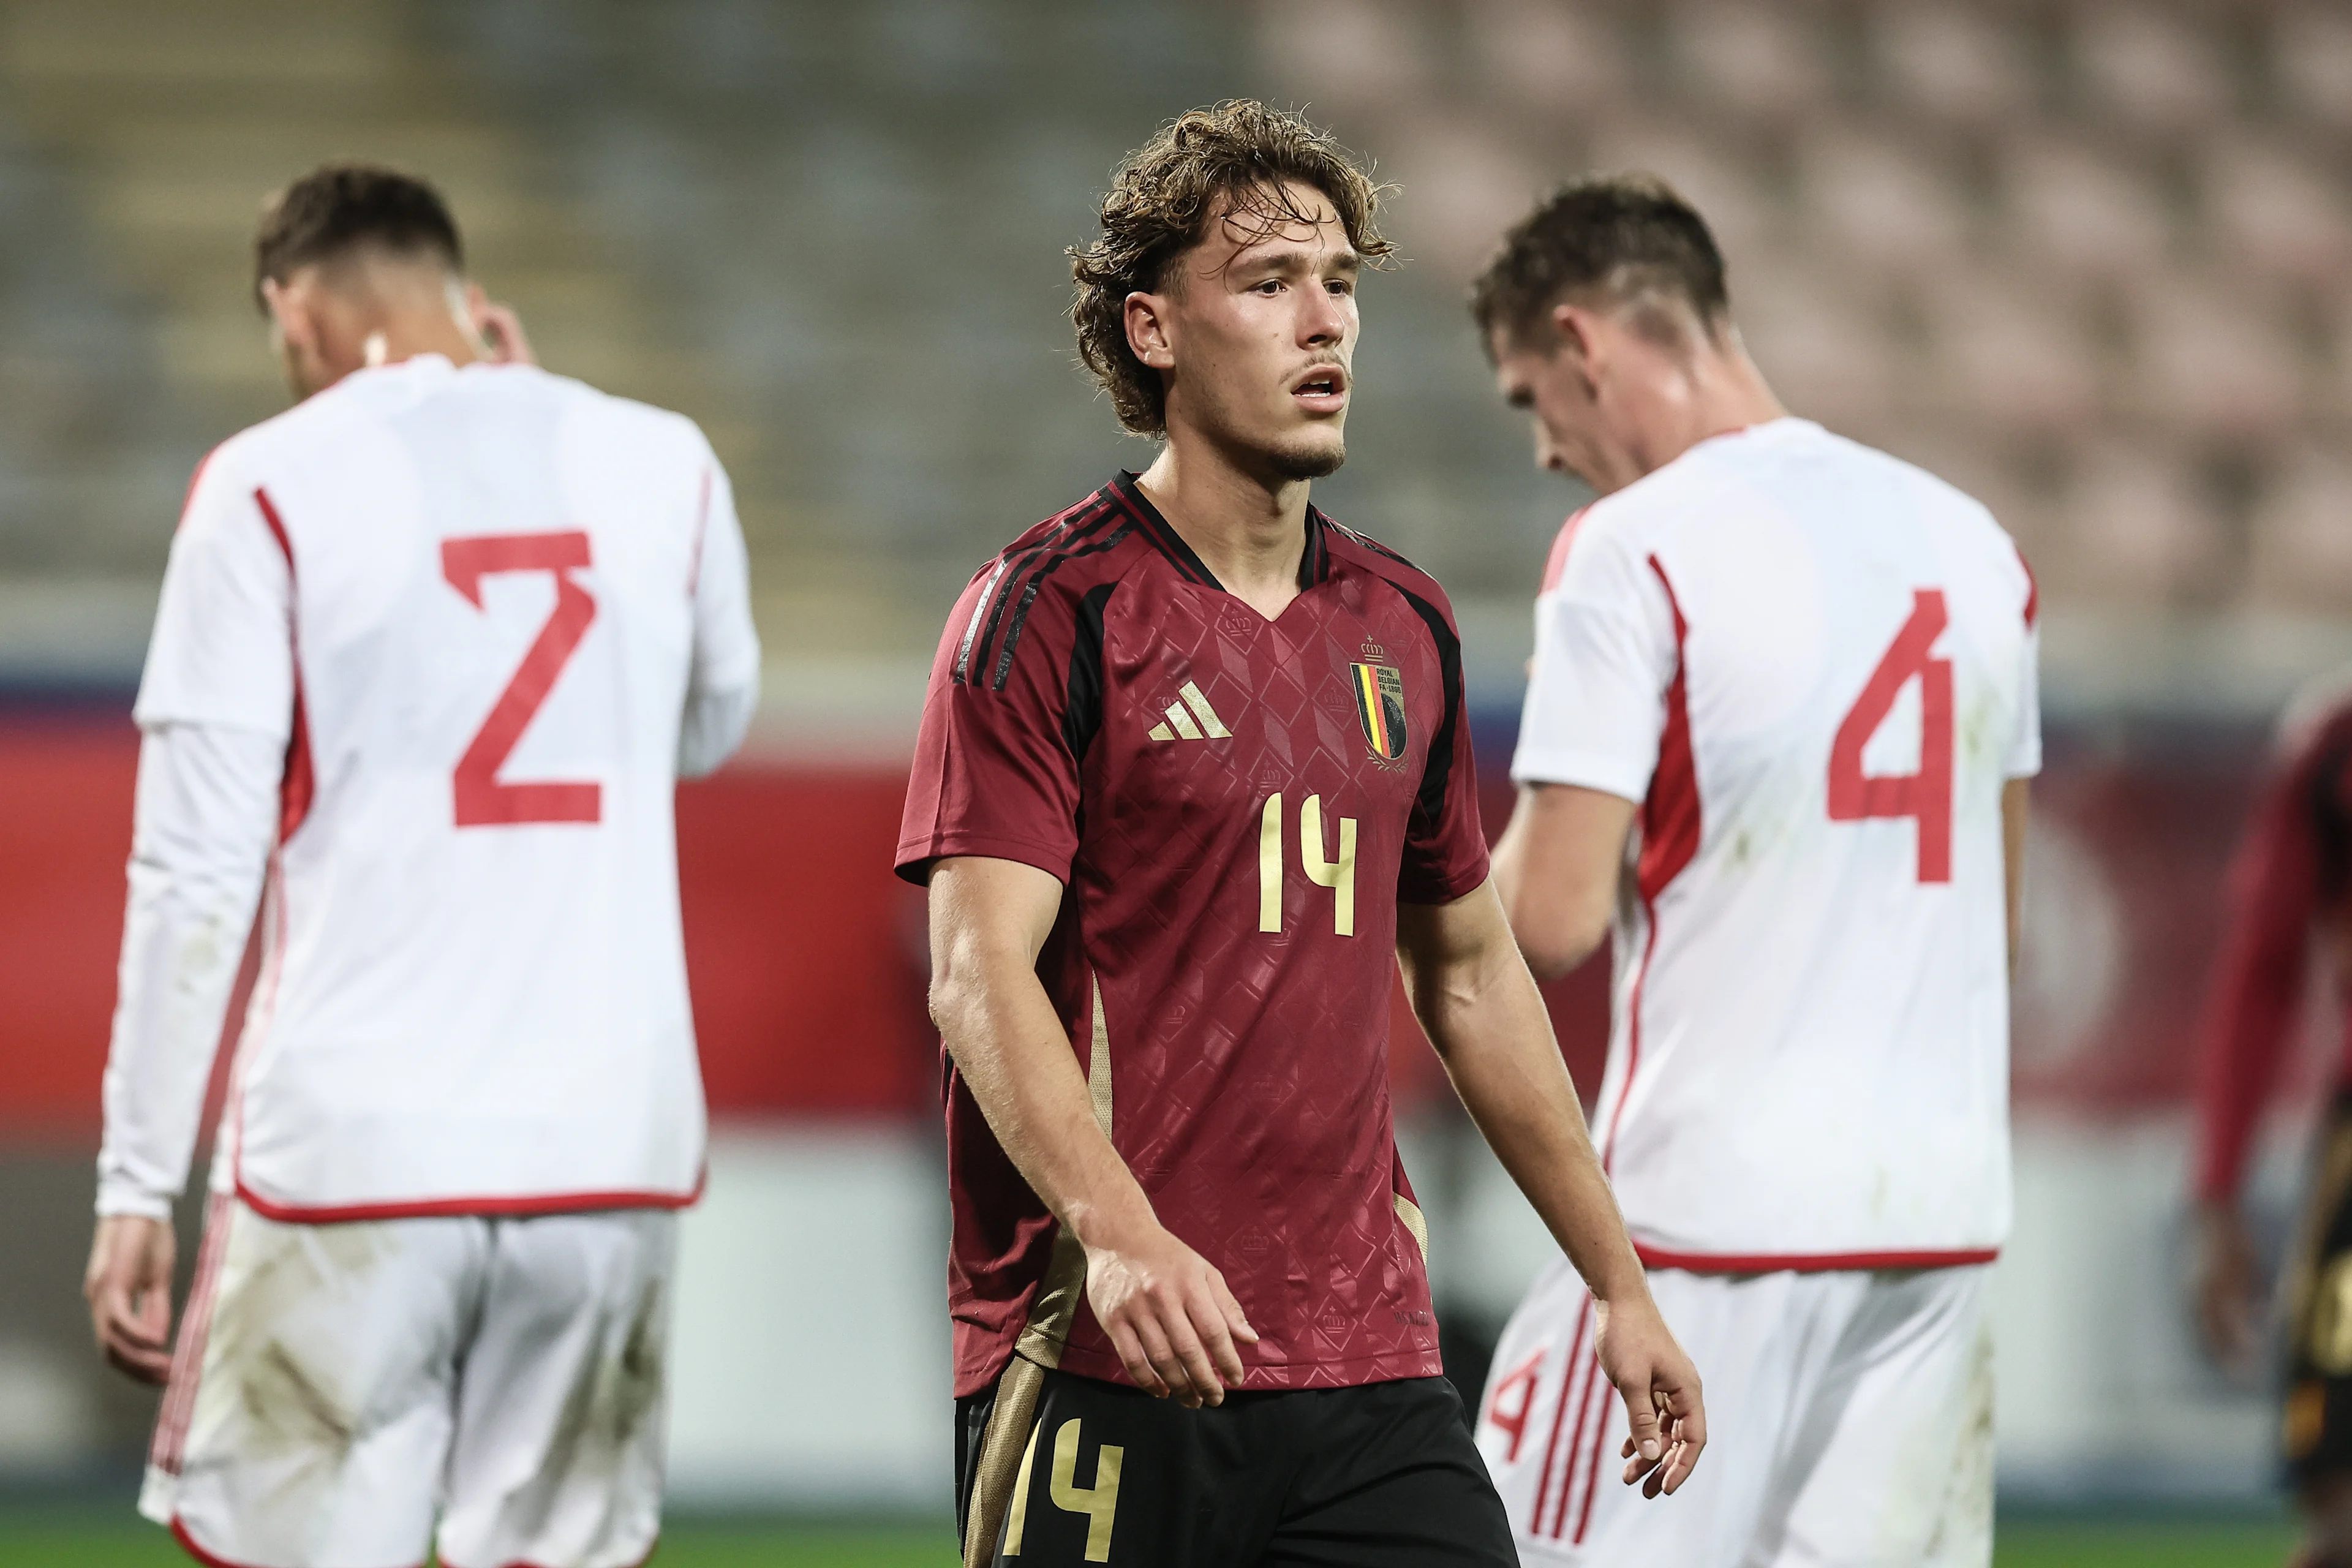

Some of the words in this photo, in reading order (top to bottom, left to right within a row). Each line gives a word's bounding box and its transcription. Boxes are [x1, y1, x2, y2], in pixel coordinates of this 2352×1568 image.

[440, 532, 600, 825] 2
[1376, 668, 1393, 677] ROYAL
[1378, 676, 1400, 685] BELGIAN
[1828, 589, 1952, 882] 4
[1259, 791, 1357, 937] 14
[1489, 1348, 1547, 1463] 4
[1002, 1418, 1124, 1563] 14
